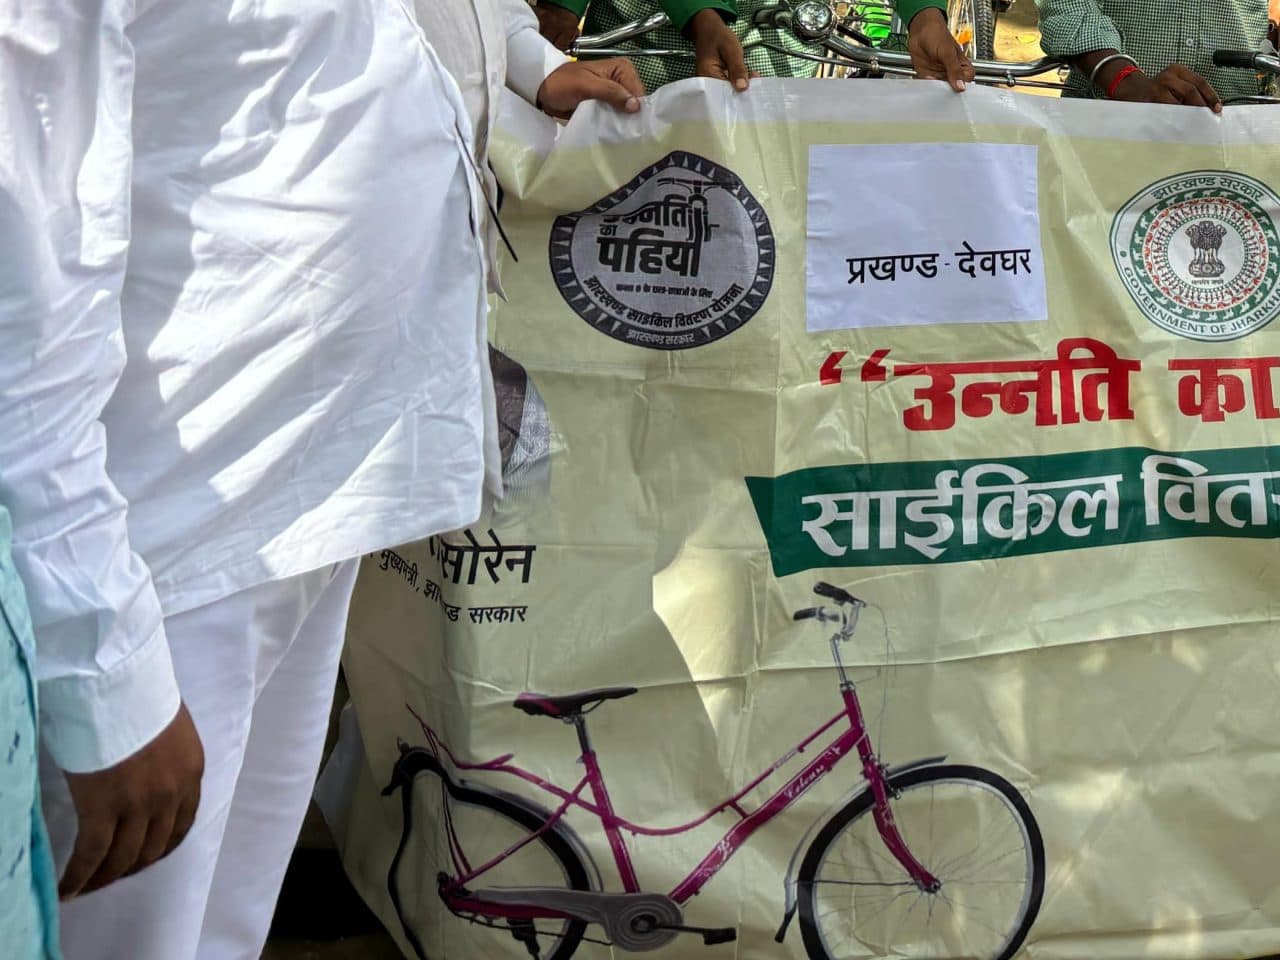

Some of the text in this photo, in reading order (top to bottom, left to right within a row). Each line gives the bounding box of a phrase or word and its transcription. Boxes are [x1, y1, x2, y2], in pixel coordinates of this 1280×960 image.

[1152, 176, 1264, 202] झारखण्ड सरकार
[596, 227, 703, 277] पहिया
[599, 223, 618, 236] का
[846, 249, 939, 284] प्रखण्ड
[956, 241, 1032, 282] देवघर
[583, 275, 628, 315] झारखण्ड
[675, 310, 712, 328] वितरण
[711, 283, 745, 313] योजना
[1124, 267, 1206, 334] GOVERNMENT
[1210, 323, 1228, 334] OF
[1167, 356, 1280, 423] का
[801, 463, 1123, 560] साईकिल
[440, 528, 537, 585] सोरेन
[467, 606, 529, 624] सरकार
